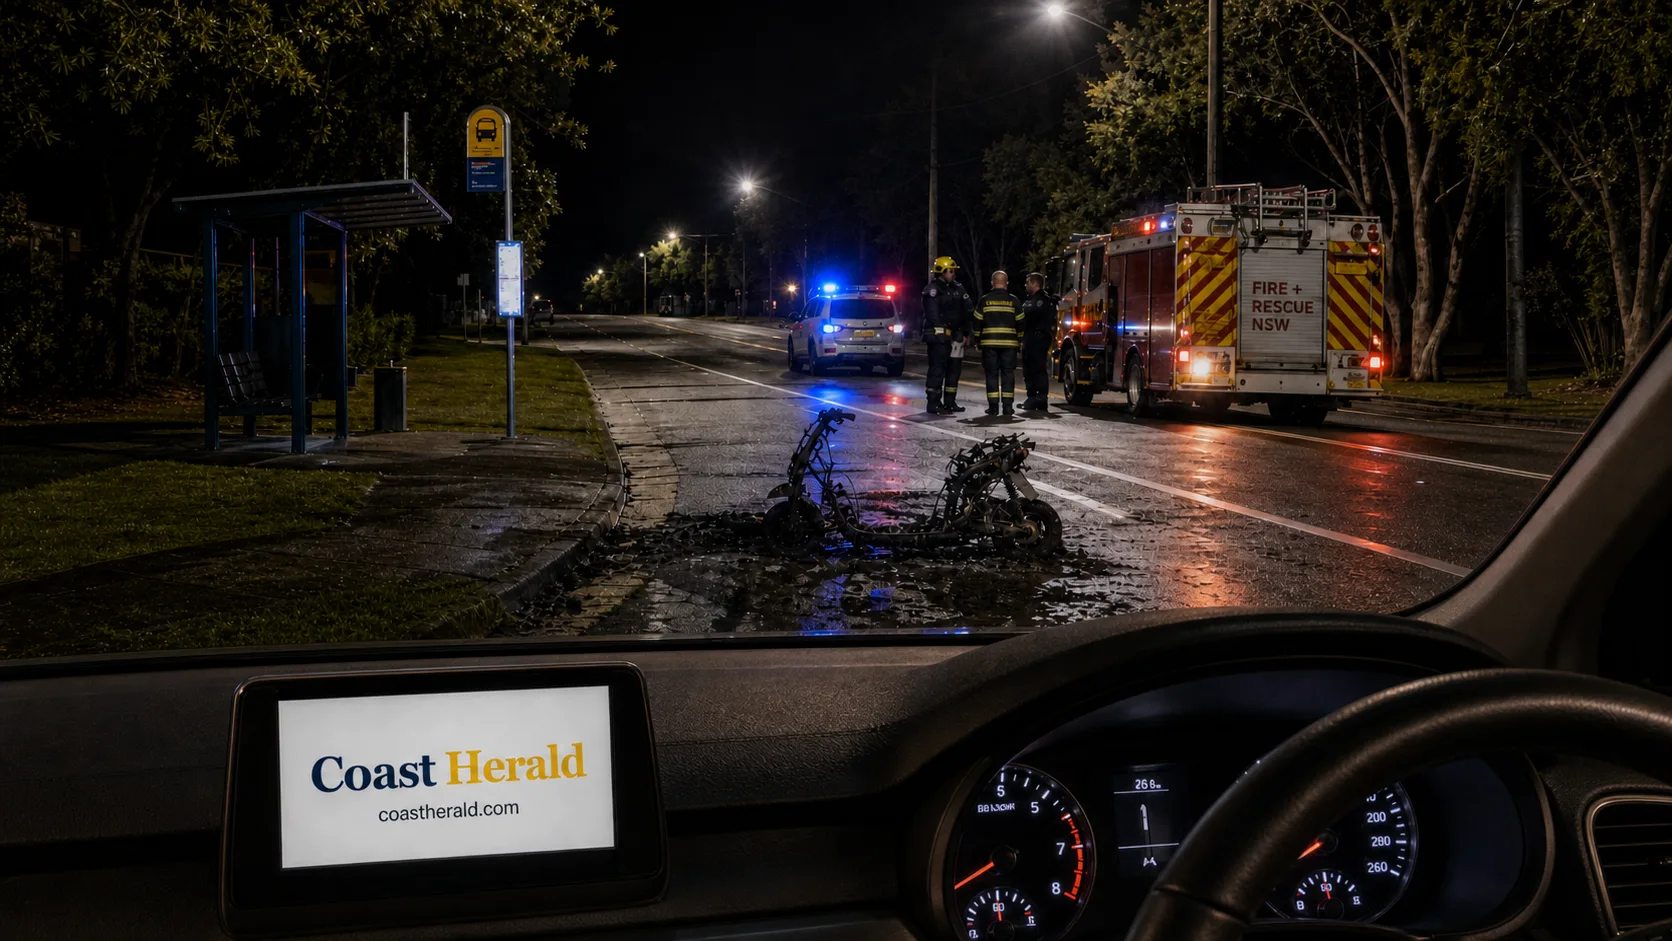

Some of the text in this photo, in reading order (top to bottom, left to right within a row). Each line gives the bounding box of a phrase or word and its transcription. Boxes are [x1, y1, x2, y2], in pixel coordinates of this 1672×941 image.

[1252, 281, 1303, 295] FIRE +
[1252, 300, 1314, 314] RESCUE
[1252, 317, 1290, 331] NSW
[311, 741, 588, 793] Coast Herald
[378, 800, 520, 823] coastherald.com
[1030, 801, 1040, 814] 5
[1366, 811, 1387, 824] 200
[1370, 835, 1391, 848] 280
[1056, 842, 1066, 856] 7
[1366, 861, 1388, 874] 260
[1051, 881, 1061, 895] 8
